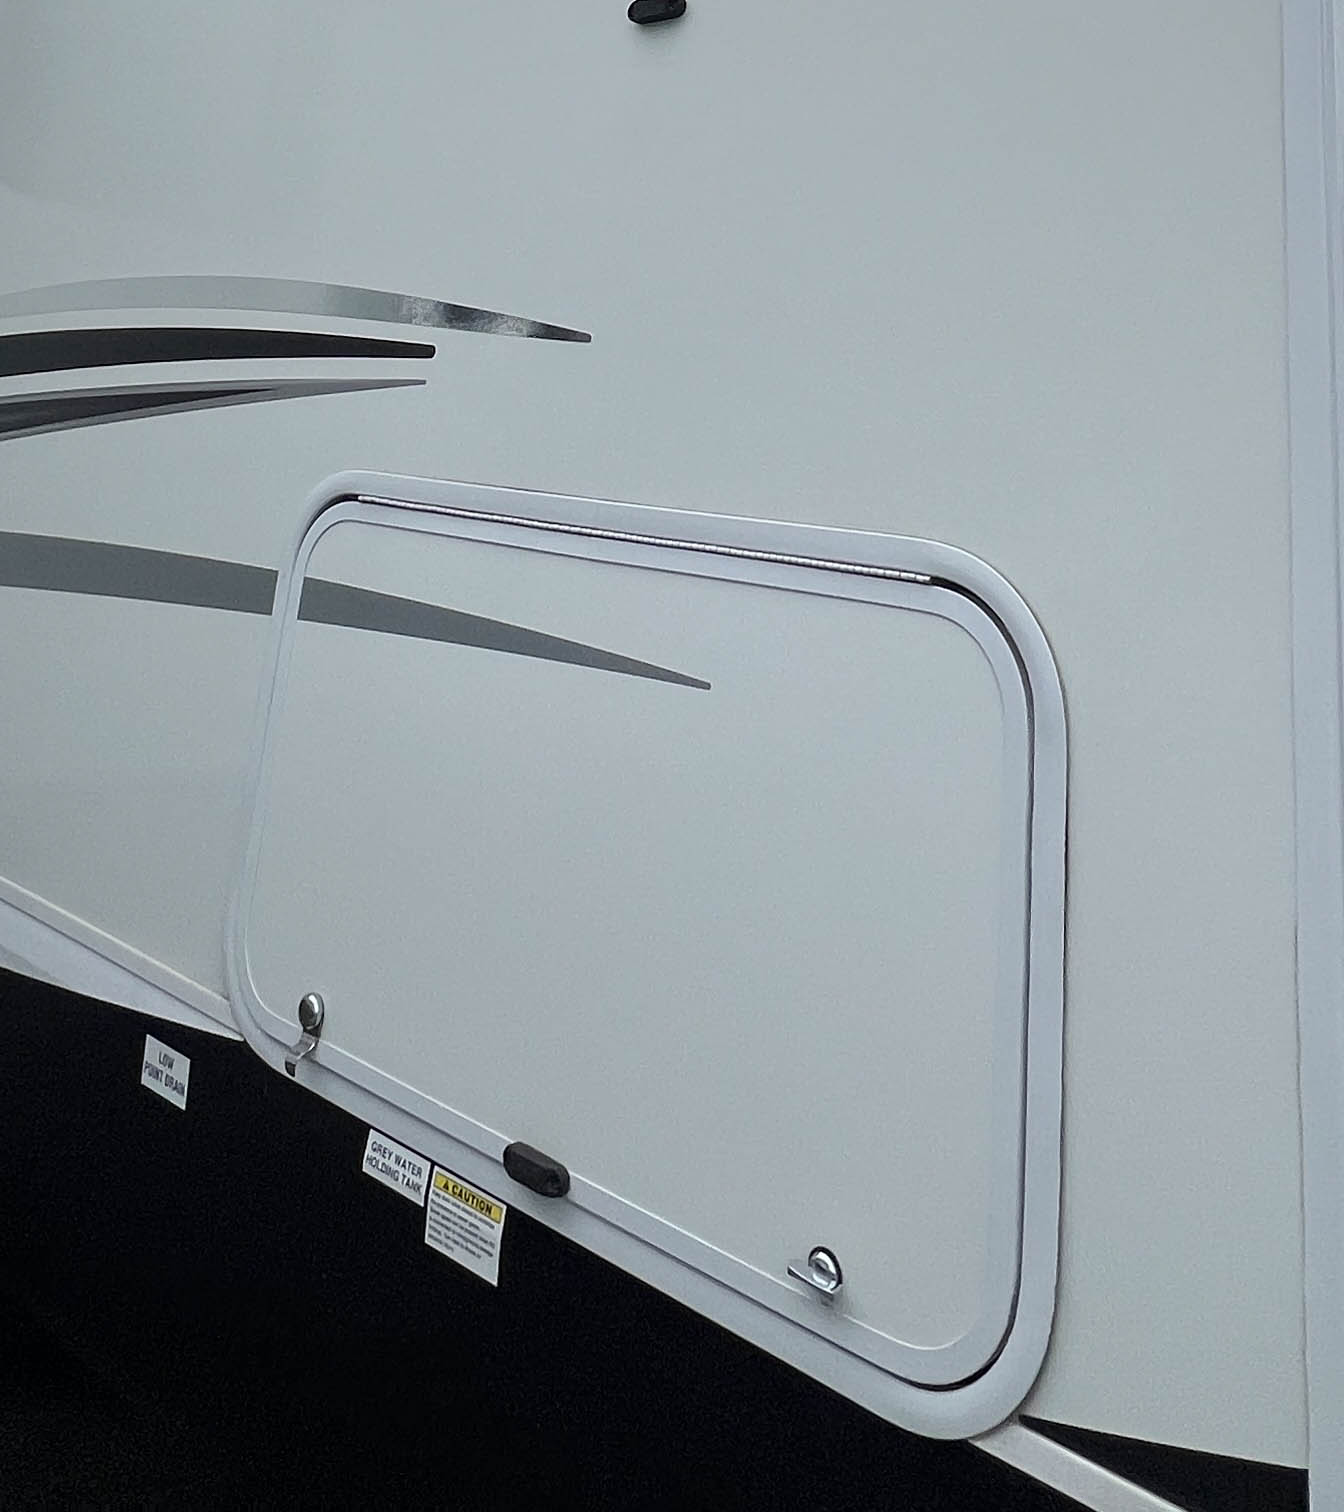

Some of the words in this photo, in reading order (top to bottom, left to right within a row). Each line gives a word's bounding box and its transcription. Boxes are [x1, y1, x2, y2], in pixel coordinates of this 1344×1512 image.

[159, 1051, 175, 1070] LOW
[366, 1153, 399, 1182] HOLDING
[402, 1173, 422, 1195] TANK
[371, 1141, 393, 1161] GREY
[395, 1154, 422, 1179] WATER
[452, 1185, 492, 1214] CAUTION
